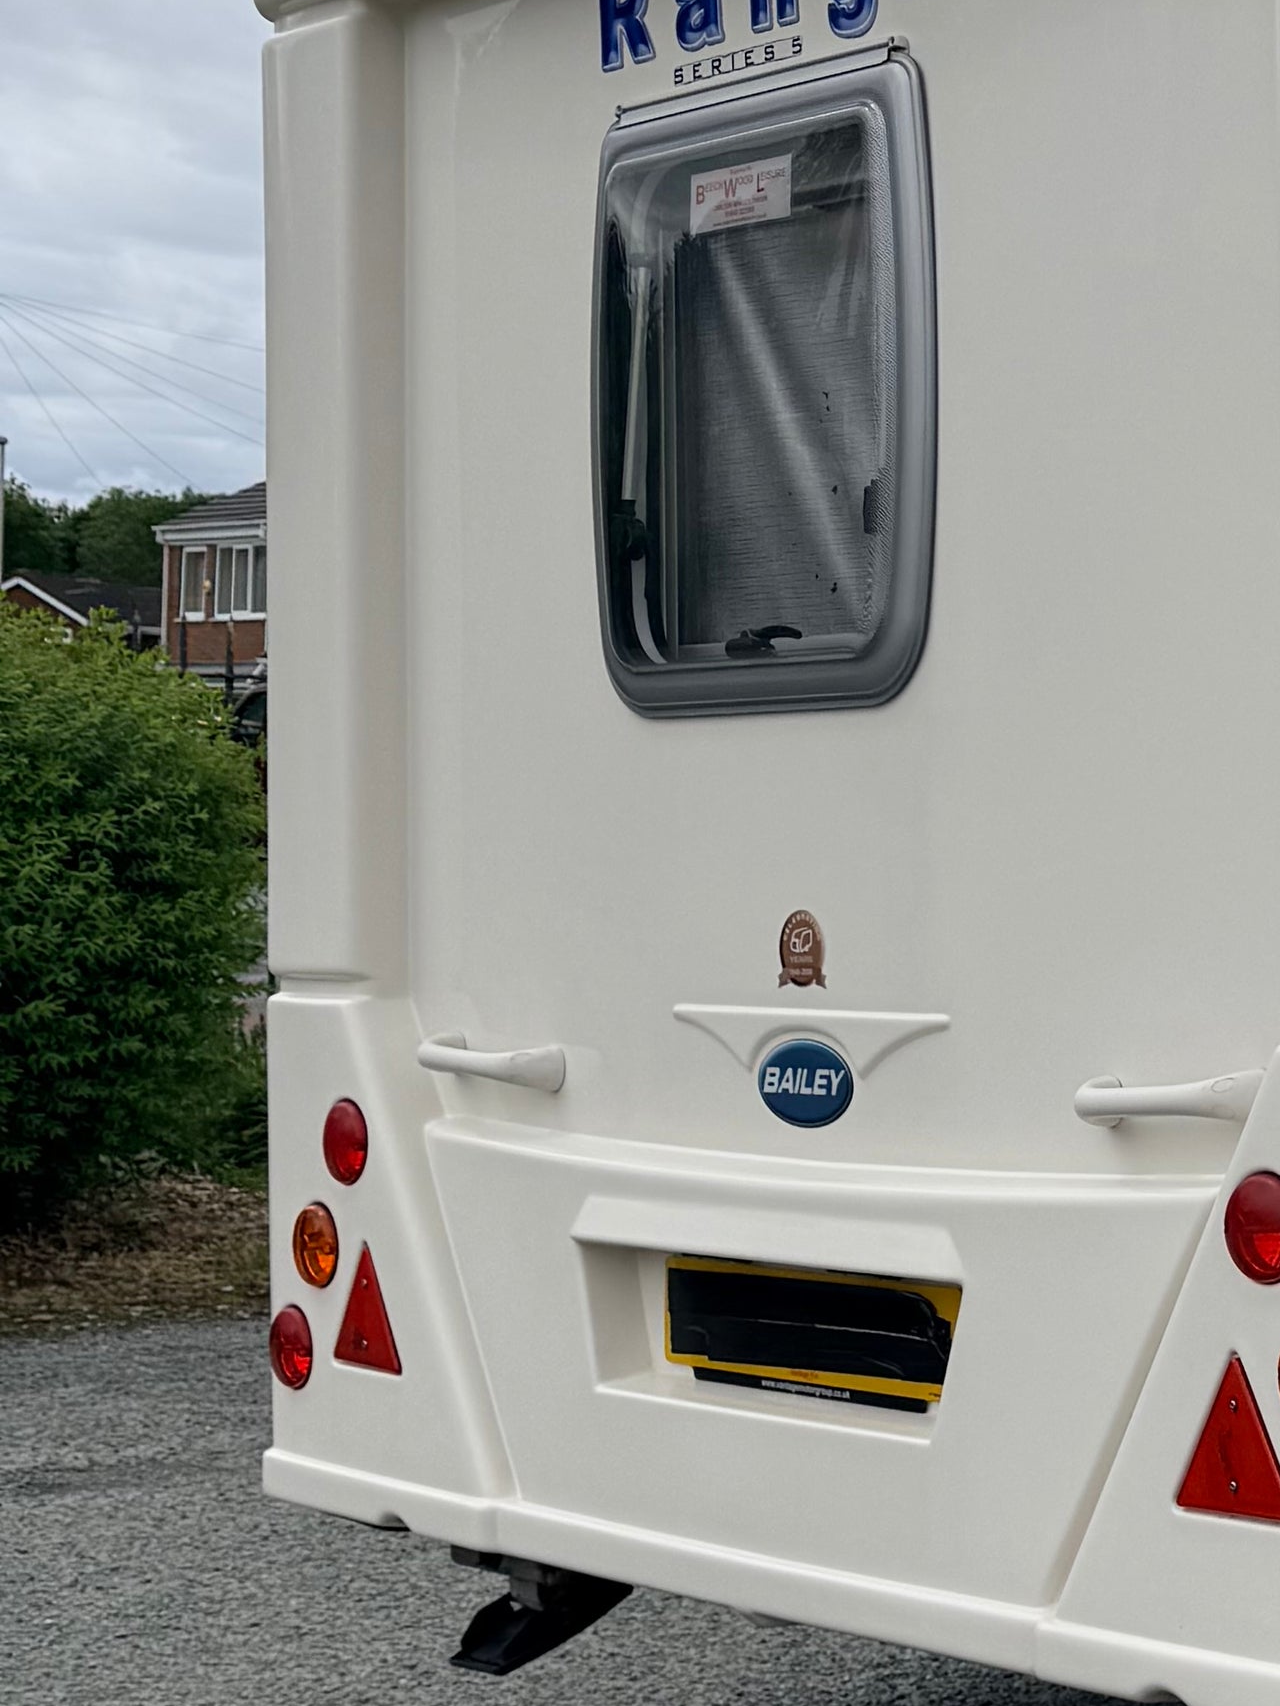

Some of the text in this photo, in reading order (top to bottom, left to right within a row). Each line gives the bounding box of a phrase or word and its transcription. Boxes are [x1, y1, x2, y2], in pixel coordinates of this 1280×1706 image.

[674, 37, 802, 86] SERIES 5
[763, 1067, 846, 1096] BAILEY
